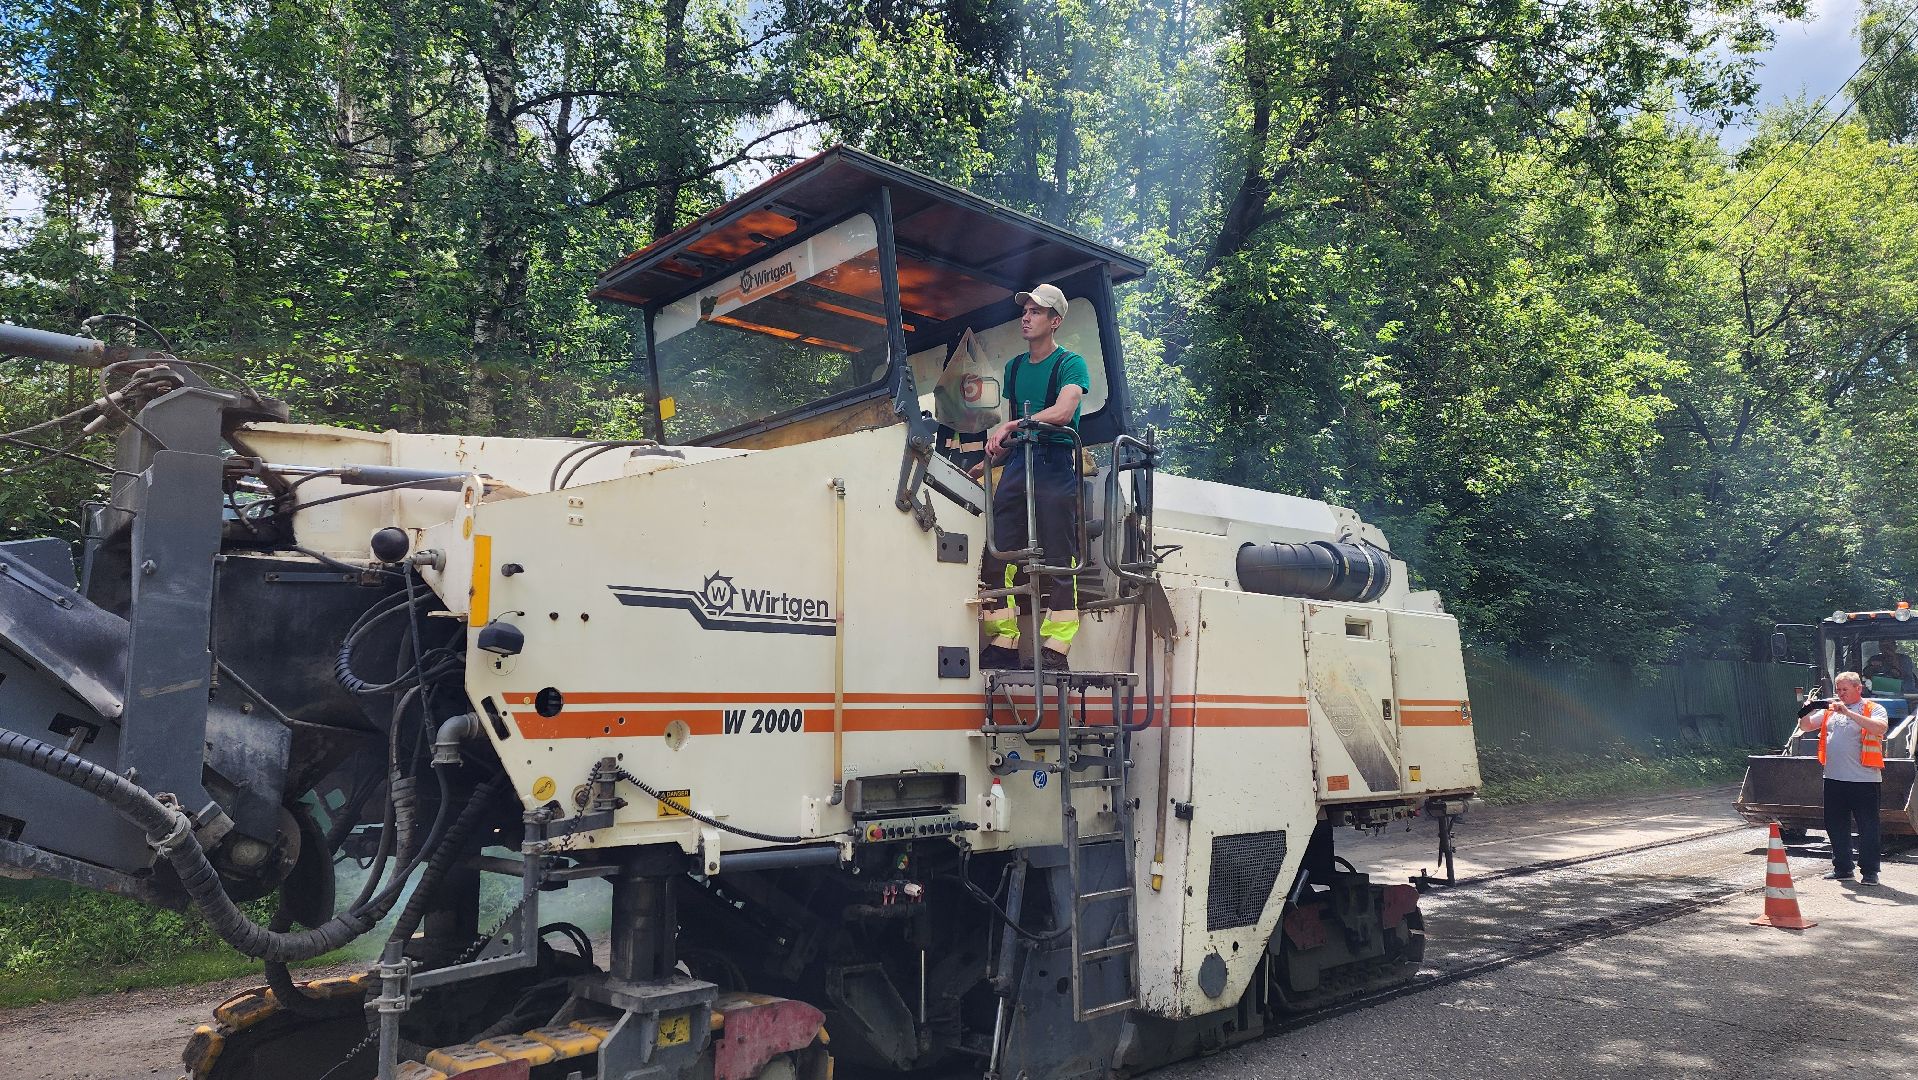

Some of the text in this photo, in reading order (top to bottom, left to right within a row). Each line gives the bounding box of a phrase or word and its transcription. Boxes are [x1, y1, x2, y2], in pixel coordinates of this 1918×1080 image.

[754, 261, 793, 287] Wirtgen
[712, 586, 829, 622] W Wirtgen
[725, 708, 803, 735] W 2000
